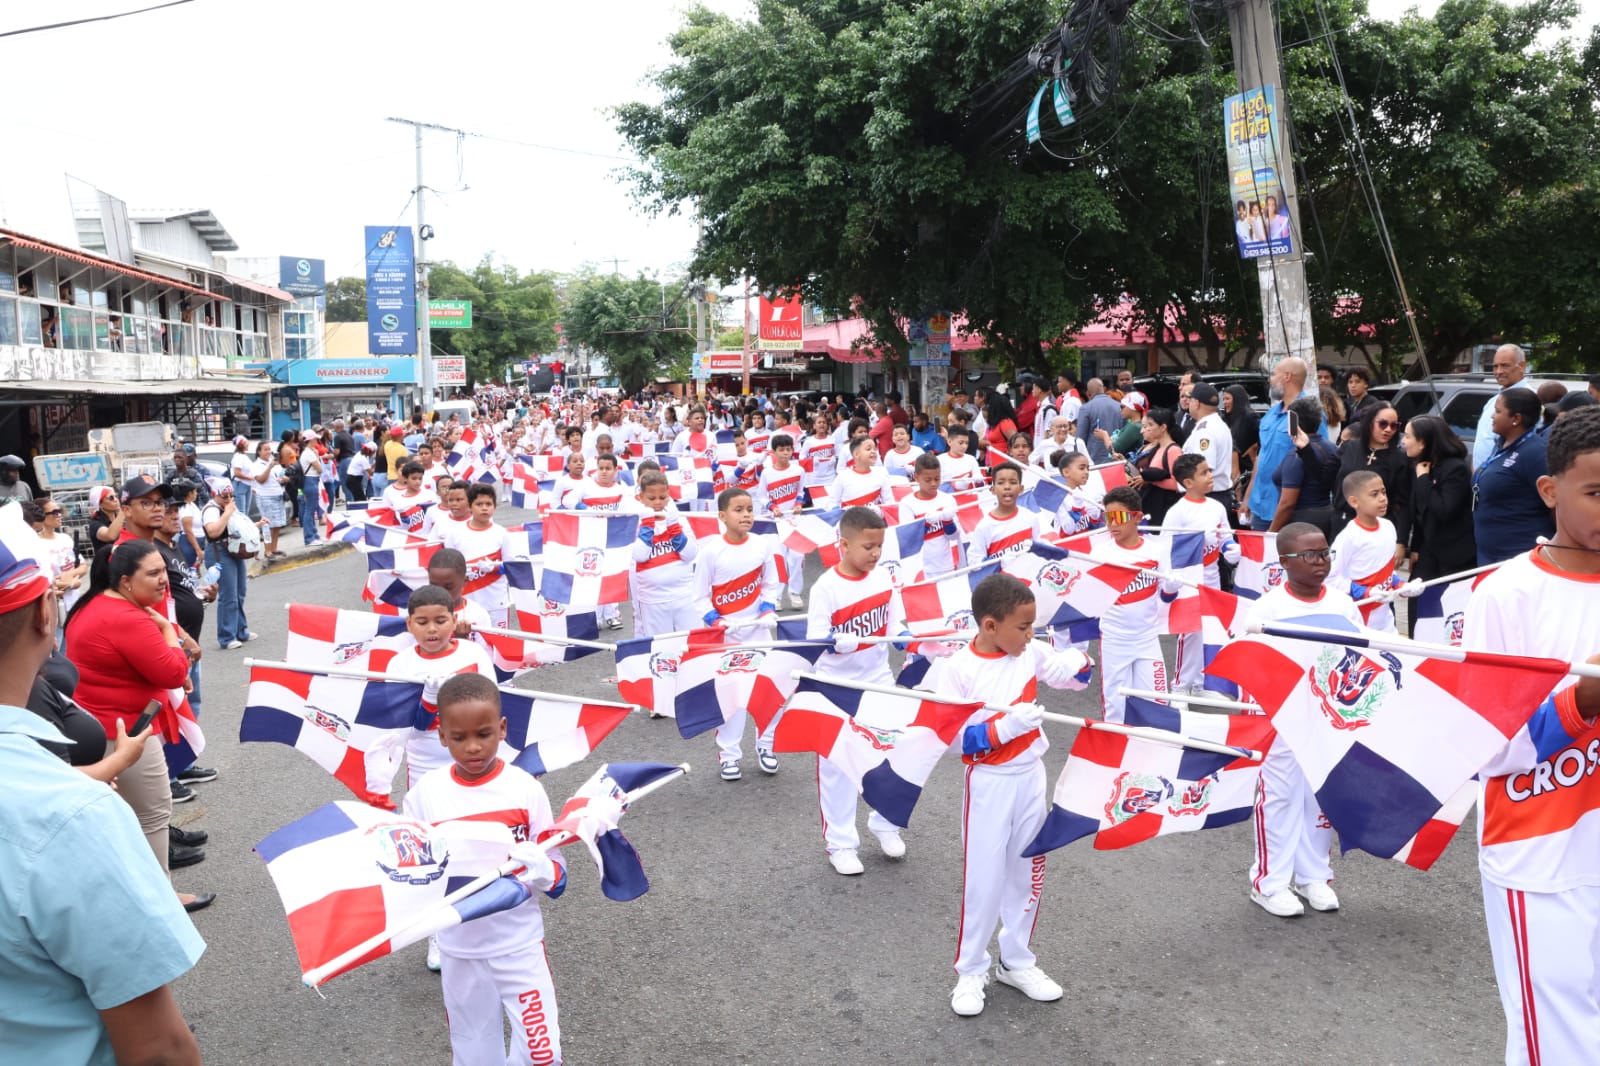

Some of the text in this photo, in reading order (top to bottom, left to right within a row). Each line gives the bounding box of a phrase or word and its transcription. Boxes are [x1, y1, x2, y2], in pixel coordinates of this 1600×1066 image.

[1230, 117, 1270, 144] Fibra
[317, 367, 390, 377] MANZANERO
[47, 461, 100, 480] Hoy
[1505, 738, 1600, 802] CROS
